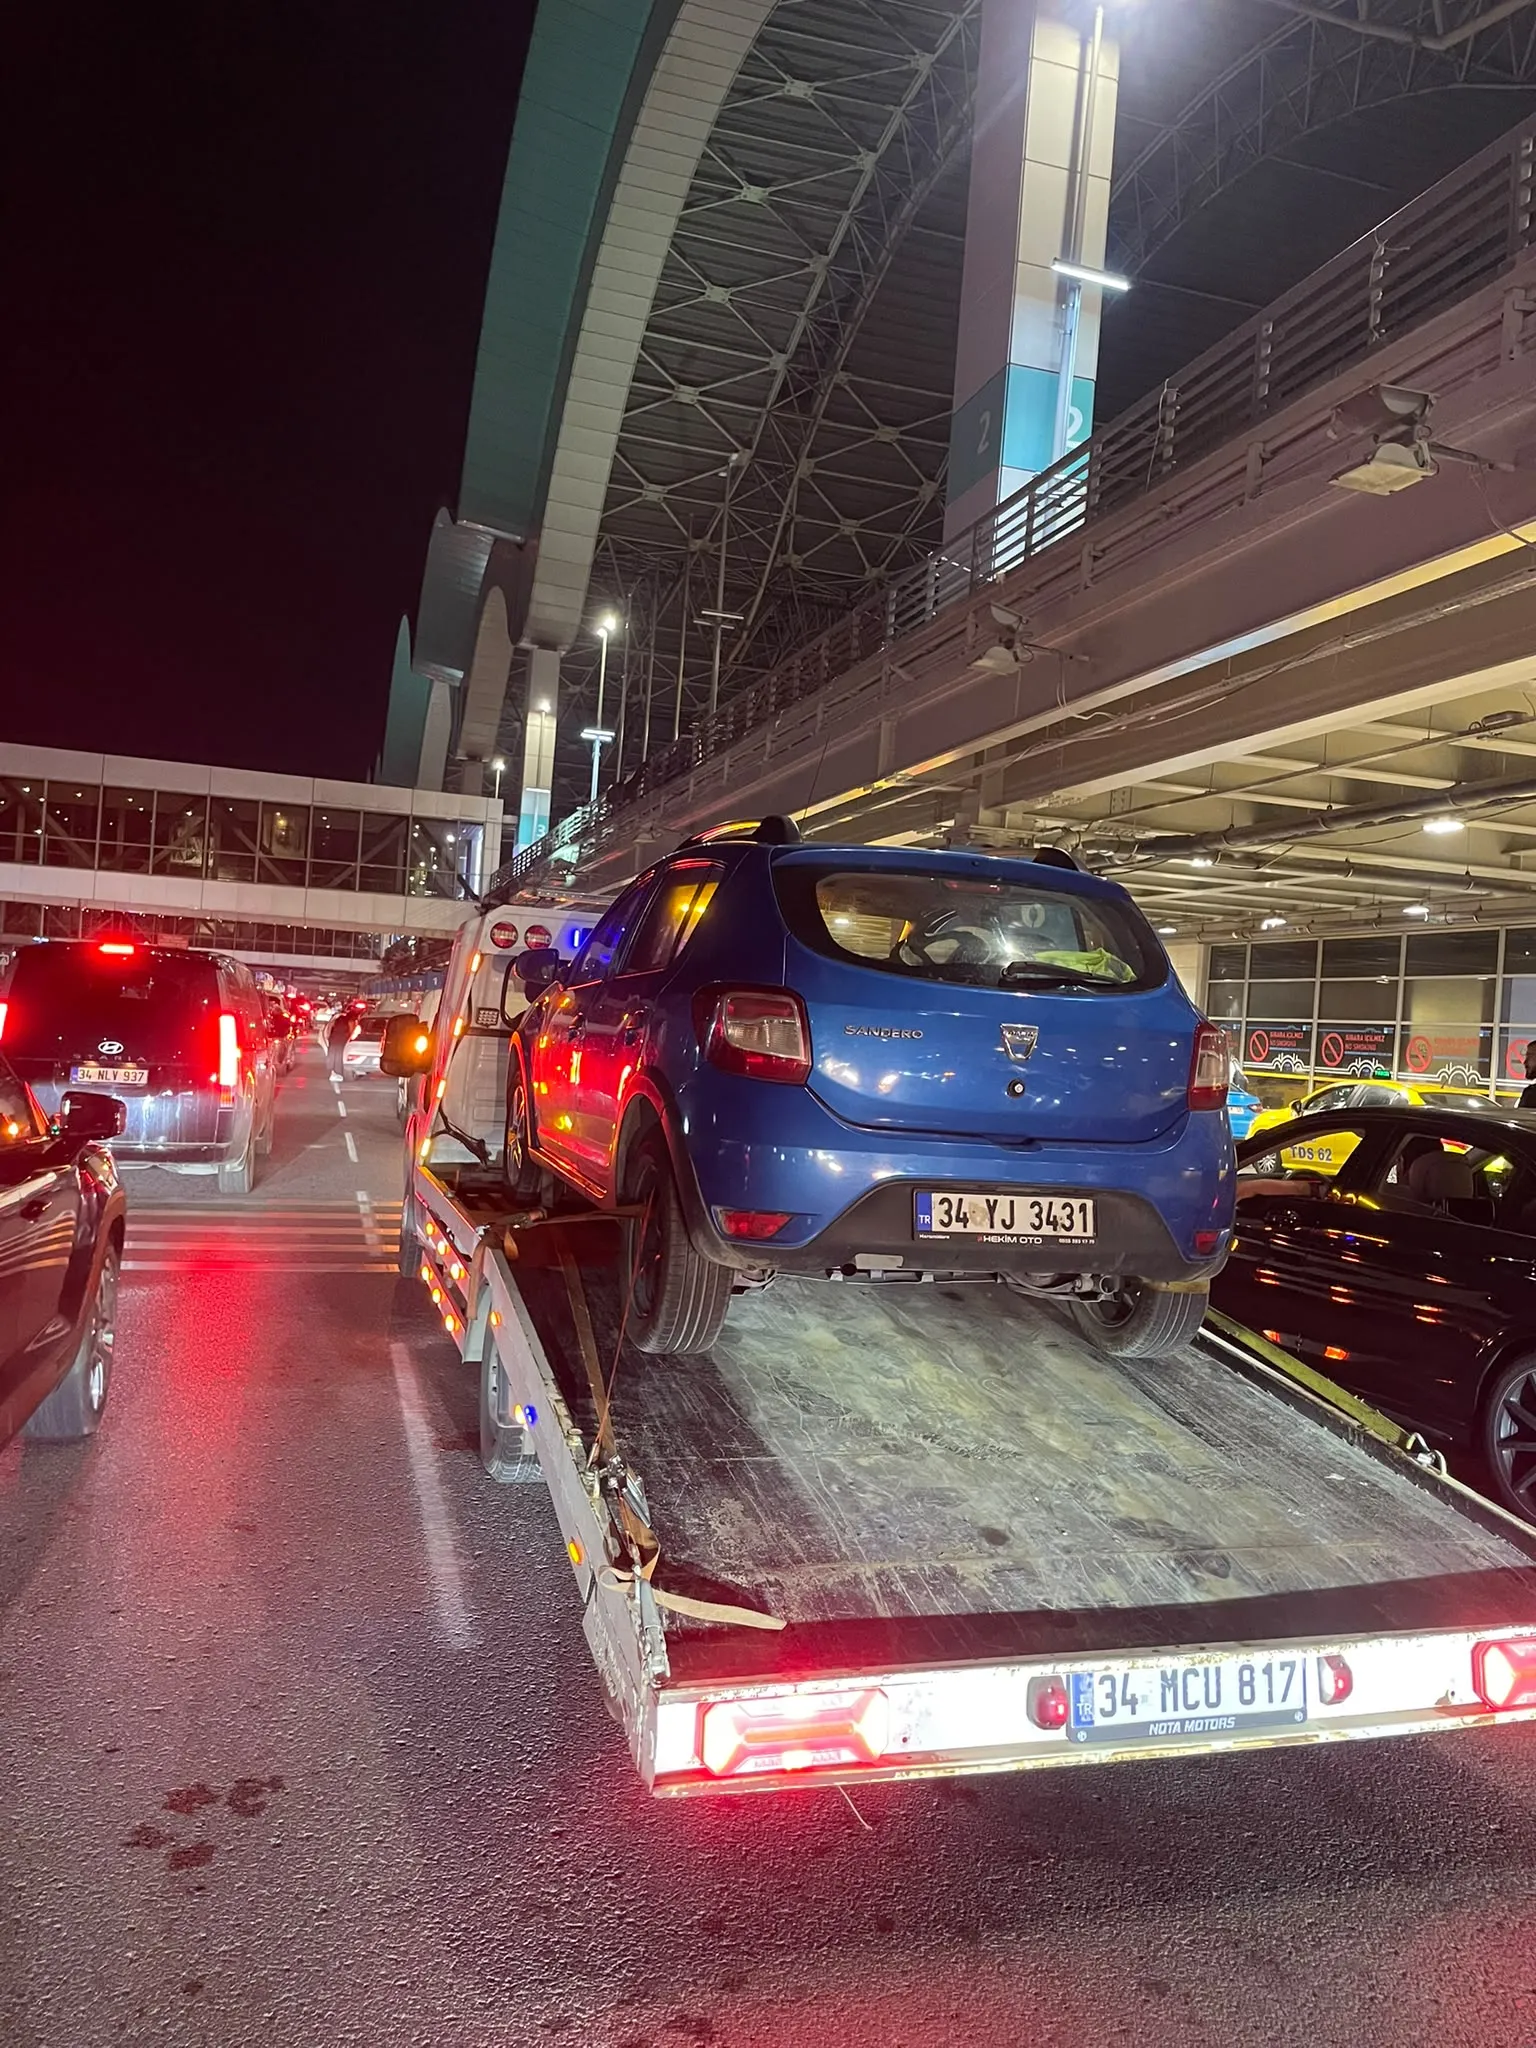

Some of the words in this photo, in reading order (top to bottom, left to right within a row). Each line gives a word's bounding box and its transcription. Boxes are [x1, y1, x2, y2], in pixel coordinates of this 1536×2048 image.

[976, 410, 991, 455] 2
[844, 1025, 924, 1040] SANDERO
[79, 1069, 92, 1080] 34
[123, 1071, 145, 1082] 937
[1290, 1146, 1315, 1160] TDS
[1317, 1147, 1333, 1161] 62
[918, 1214, 931, 1224] TR
[938, 1197, 969, 1229] 34
[985, 1198, 1015, 1230] YJ
[1029, 1200, 1088, 1233] 3431
[983, 1234, 1018, 1244] HEKİM
[1019, 1237, 1042, 1245] OTO
[1099, 1673, 1139, 1718] 34
[1160, 1666, 1222, 1713] MCU
[1238, 1660, 1297, 1706] 817
[1076, 1703, 1093, 1716] TR
[1148, 1720, 1182, 1736] NOTA
[1184, 1716, 1236, 1733] MOTORS
